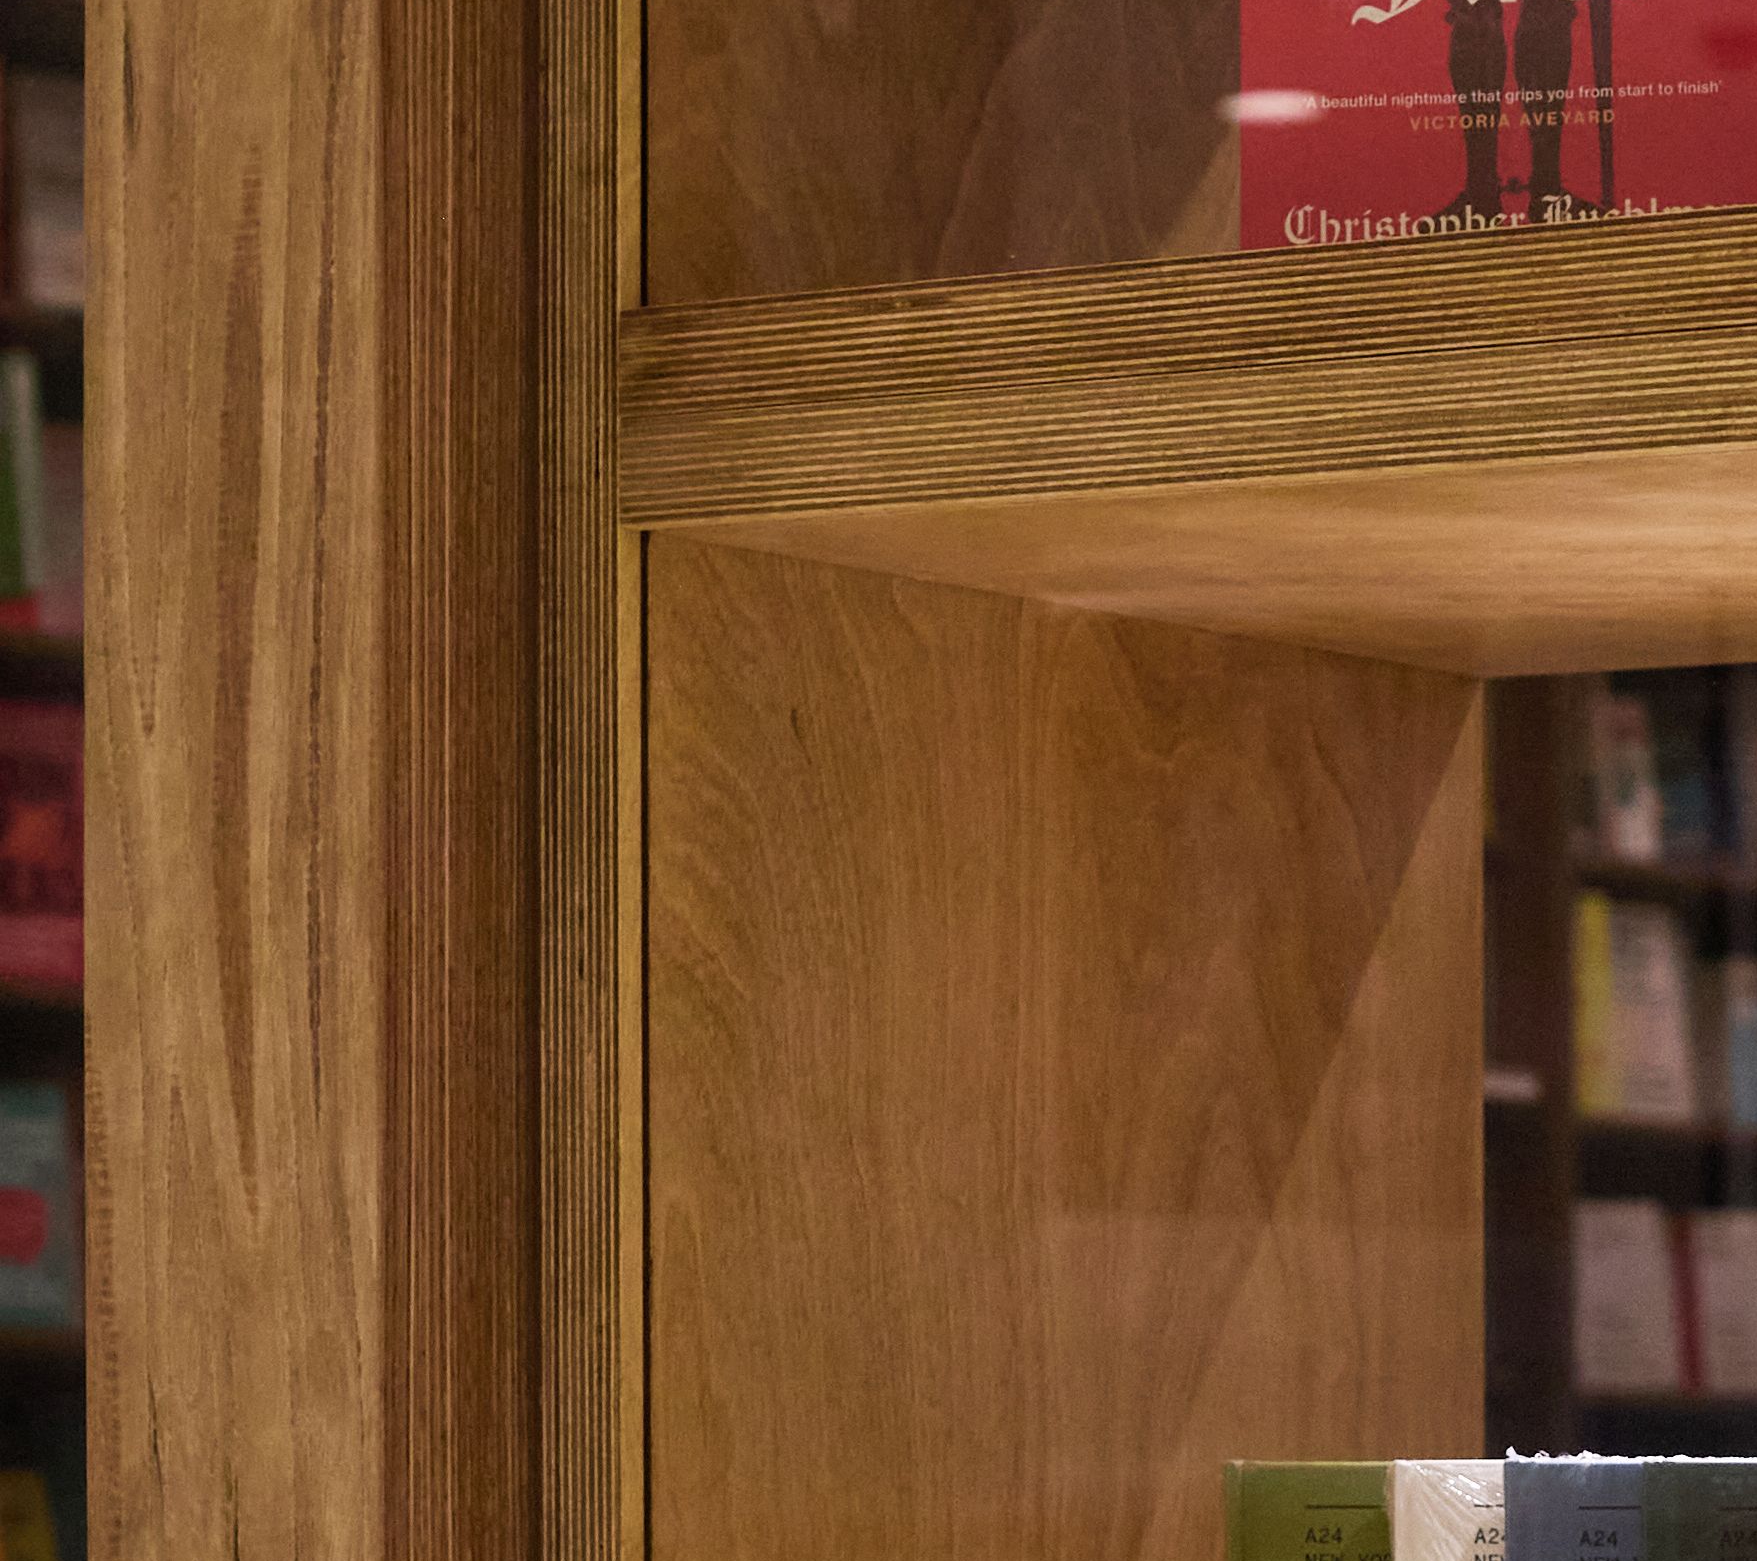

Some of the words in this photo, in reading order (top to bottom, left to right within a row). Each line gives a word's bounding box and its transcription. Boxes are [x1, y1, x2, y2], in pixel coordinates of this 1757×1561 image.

[1320, 93, 1387, 109] beautiful
[1391, 90, 1468, 109] nightmare
[1472, 89, 1502, 103] that
[1504, 87, 1543, 105] grips
[1547, 88, 1575, 103] you
[1579, 85, 1614, 99] from
[1618, 82, 1654, 97] start
[1658, 81, 1674, 95] to
[1409, 113, 1511, 132] VICTORIA
[1519, 109, 1616, 127] AVEYARD
[1284, 203, 1527, 245] Christopher
[1304, 1527, 1343, 1545] A24
[1474, 1528, 1506, 1545] A2
[1580, 1530, 1619, 1548] A24
